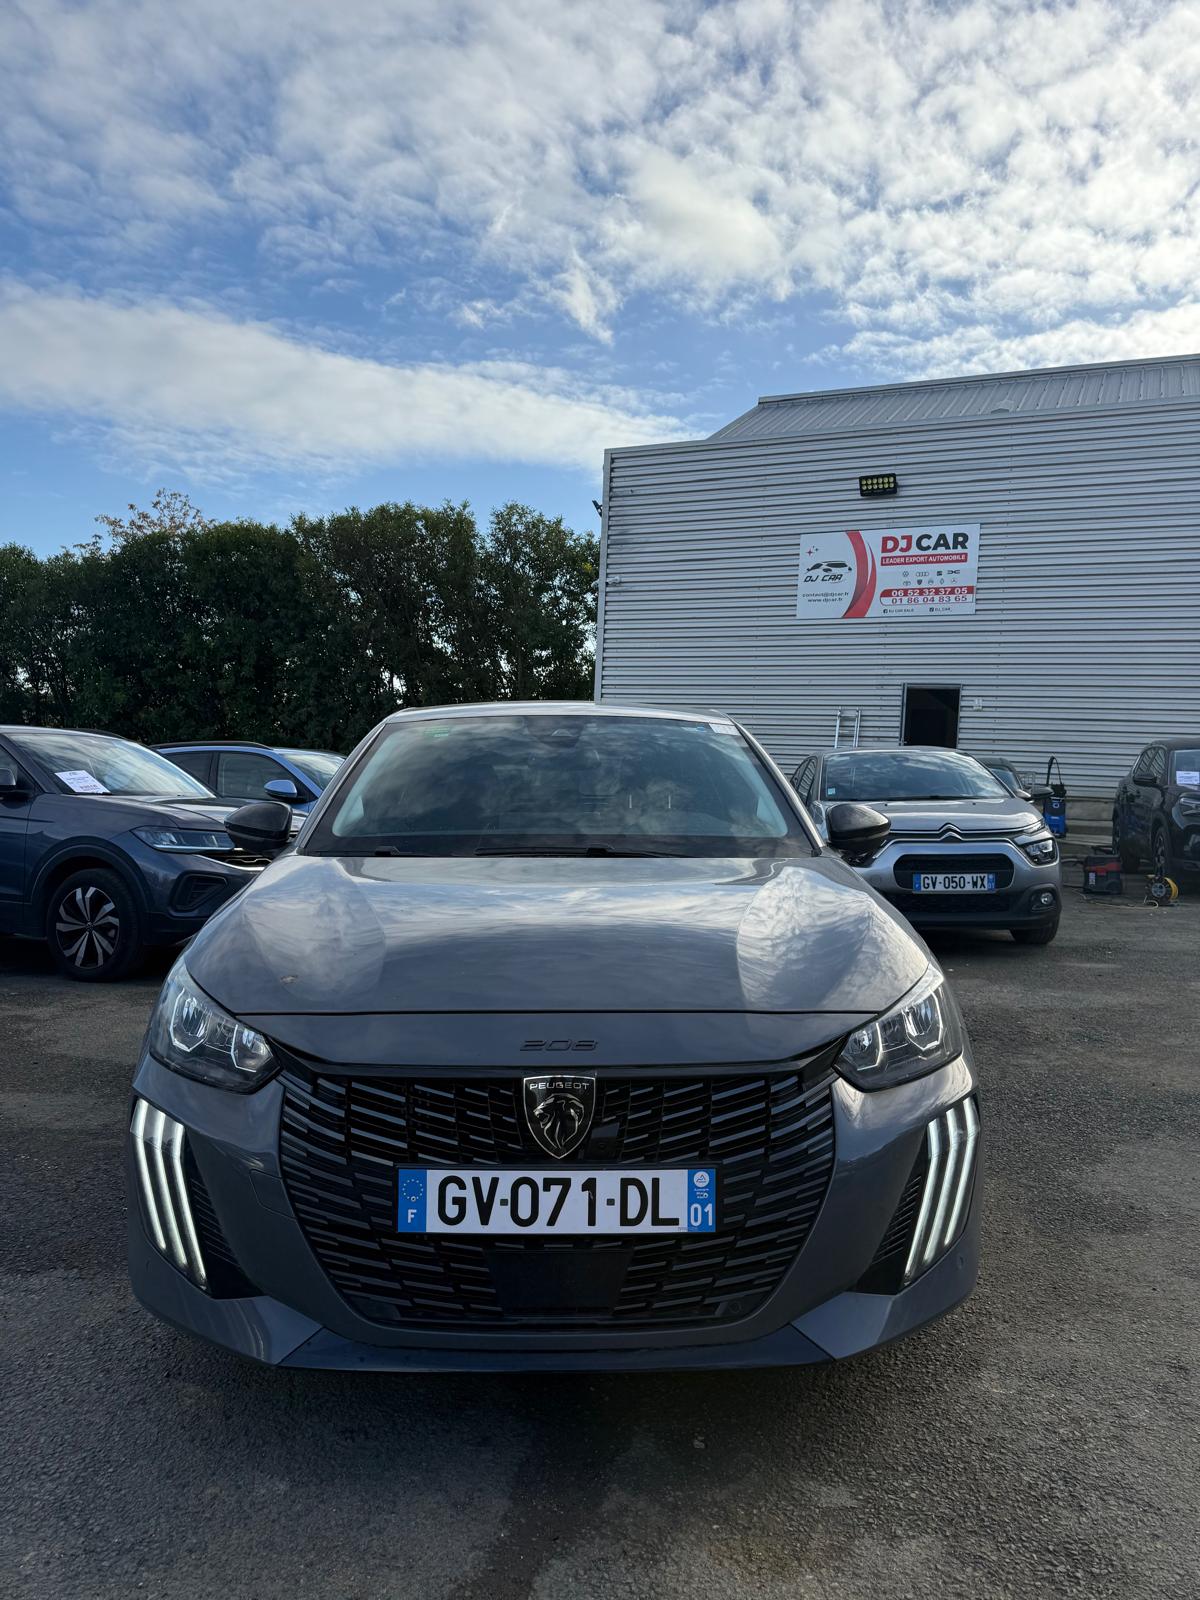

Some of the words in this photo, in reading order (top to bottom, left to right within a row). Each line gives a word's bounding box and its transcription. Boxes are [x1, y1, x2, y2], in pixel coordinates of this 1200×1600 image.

[881, 535, 912, 553] DJ
[915, 532, 969, 551] CAR
[928, 554, 966, 562] AUTOMOBILE
[922, 876, 986, 890] GV-050-WX
[520, 1039, 598, 1051] 208
[529, 1082, 590, 1090] PEUGEOT
[437, 1175, 680, 1227] GV-071-DL
[407, 1209, 417, 1223] F
[690, 1203, 713, 1227] 01
